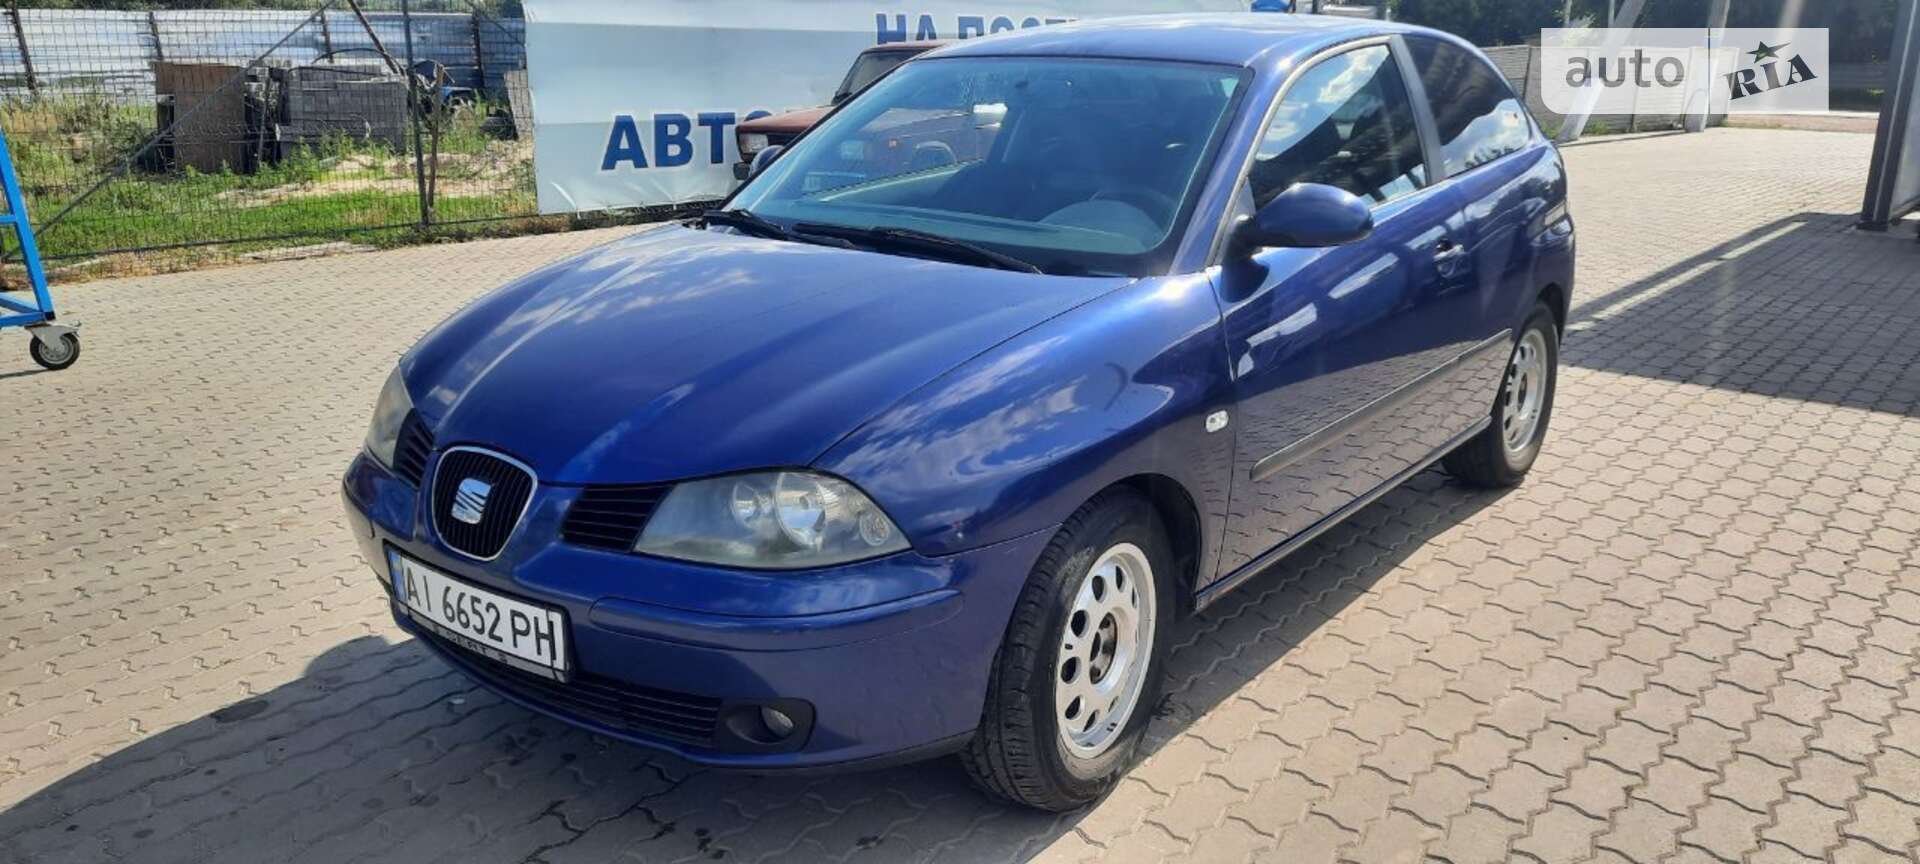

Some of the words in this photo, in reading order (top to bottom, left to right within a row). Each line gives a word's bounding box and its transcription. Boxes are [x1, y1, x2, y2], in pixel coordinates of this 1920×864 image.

[601, 110, 773, 170] АВТ
[407, 567, 431, 612] AI
[442, 586, 503, 643] 6652
[510, 609, 557, 661] PH
